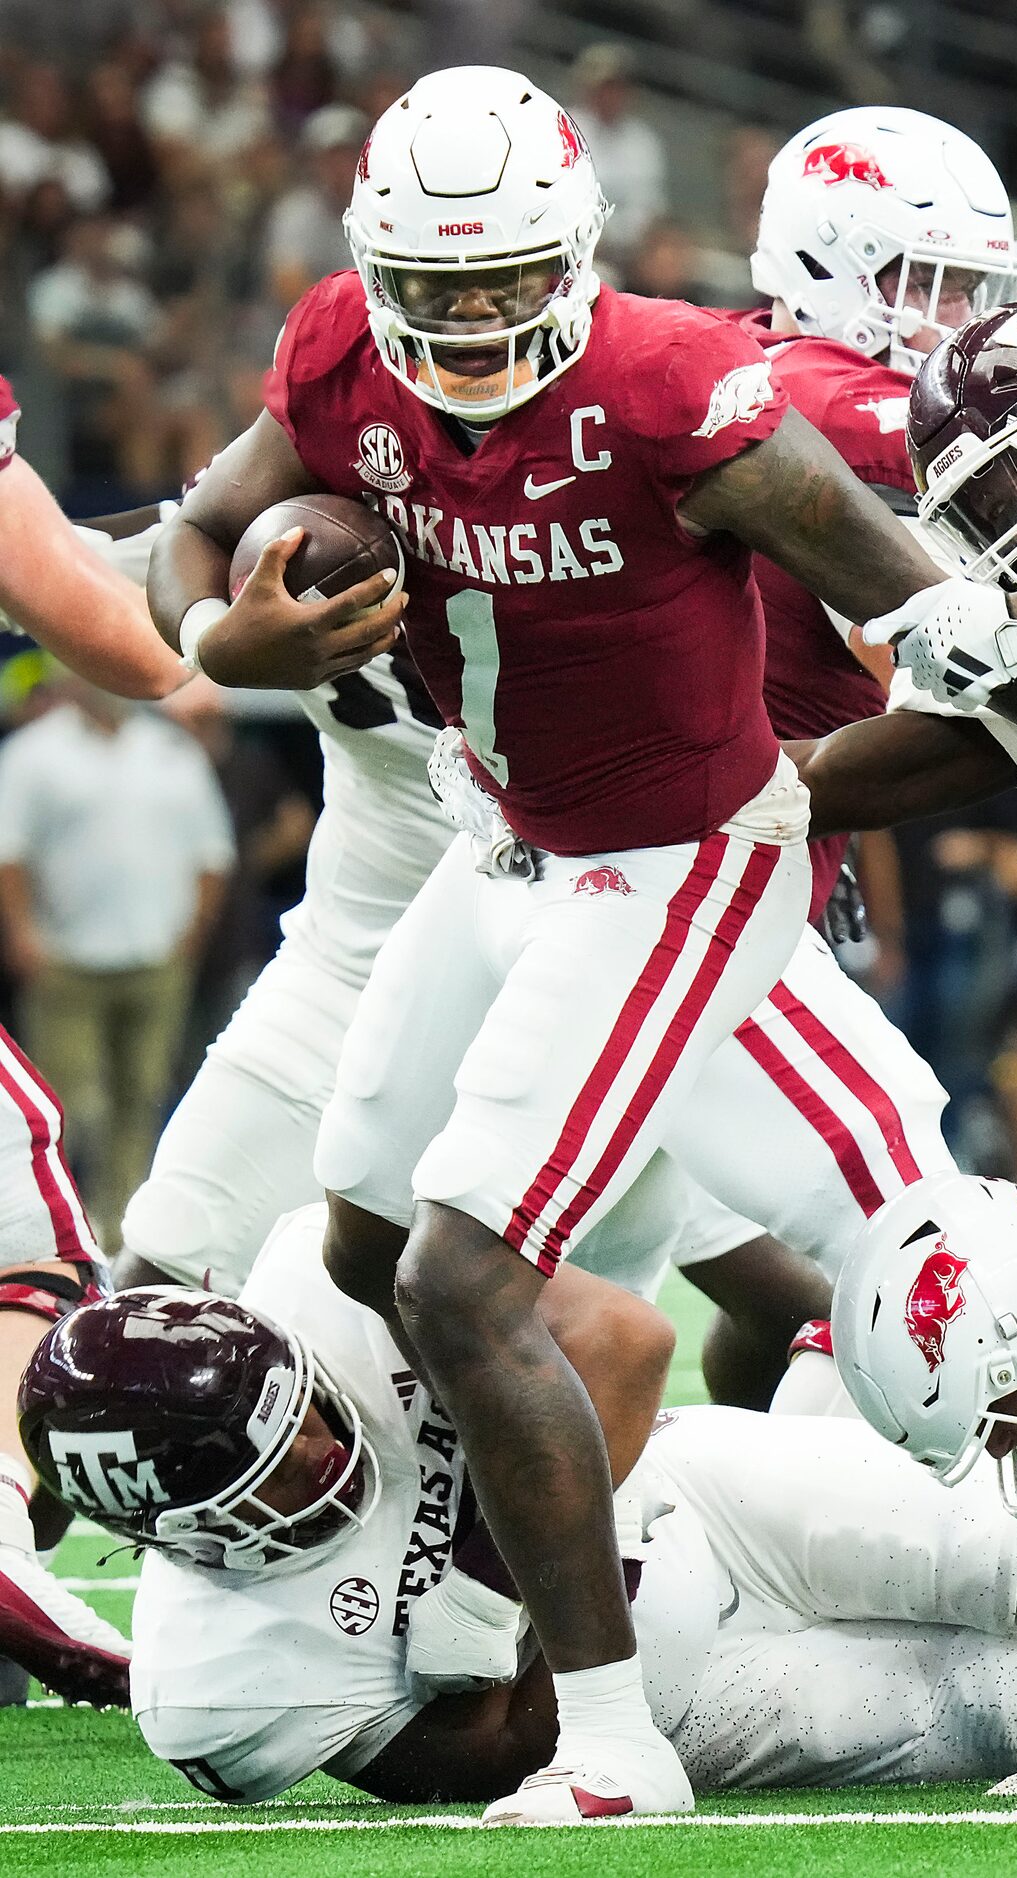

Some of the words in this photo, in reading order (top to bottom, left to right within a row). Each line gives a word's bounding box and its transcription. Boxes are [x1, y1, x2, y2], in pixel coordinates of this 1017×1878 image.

[438, 222, 484, 236] HOGS
[363, 427, 401, 474] SEC
[570, 404, 612, 472] C
[933, 444, 963, 479] AGGIES
[363, 470, 406, 490] GRADUATE
[361, 491, 625, 585] RKANSAS
[446, 588, 509, 789] 1
[331, 1578, 379, 1635] SEC
